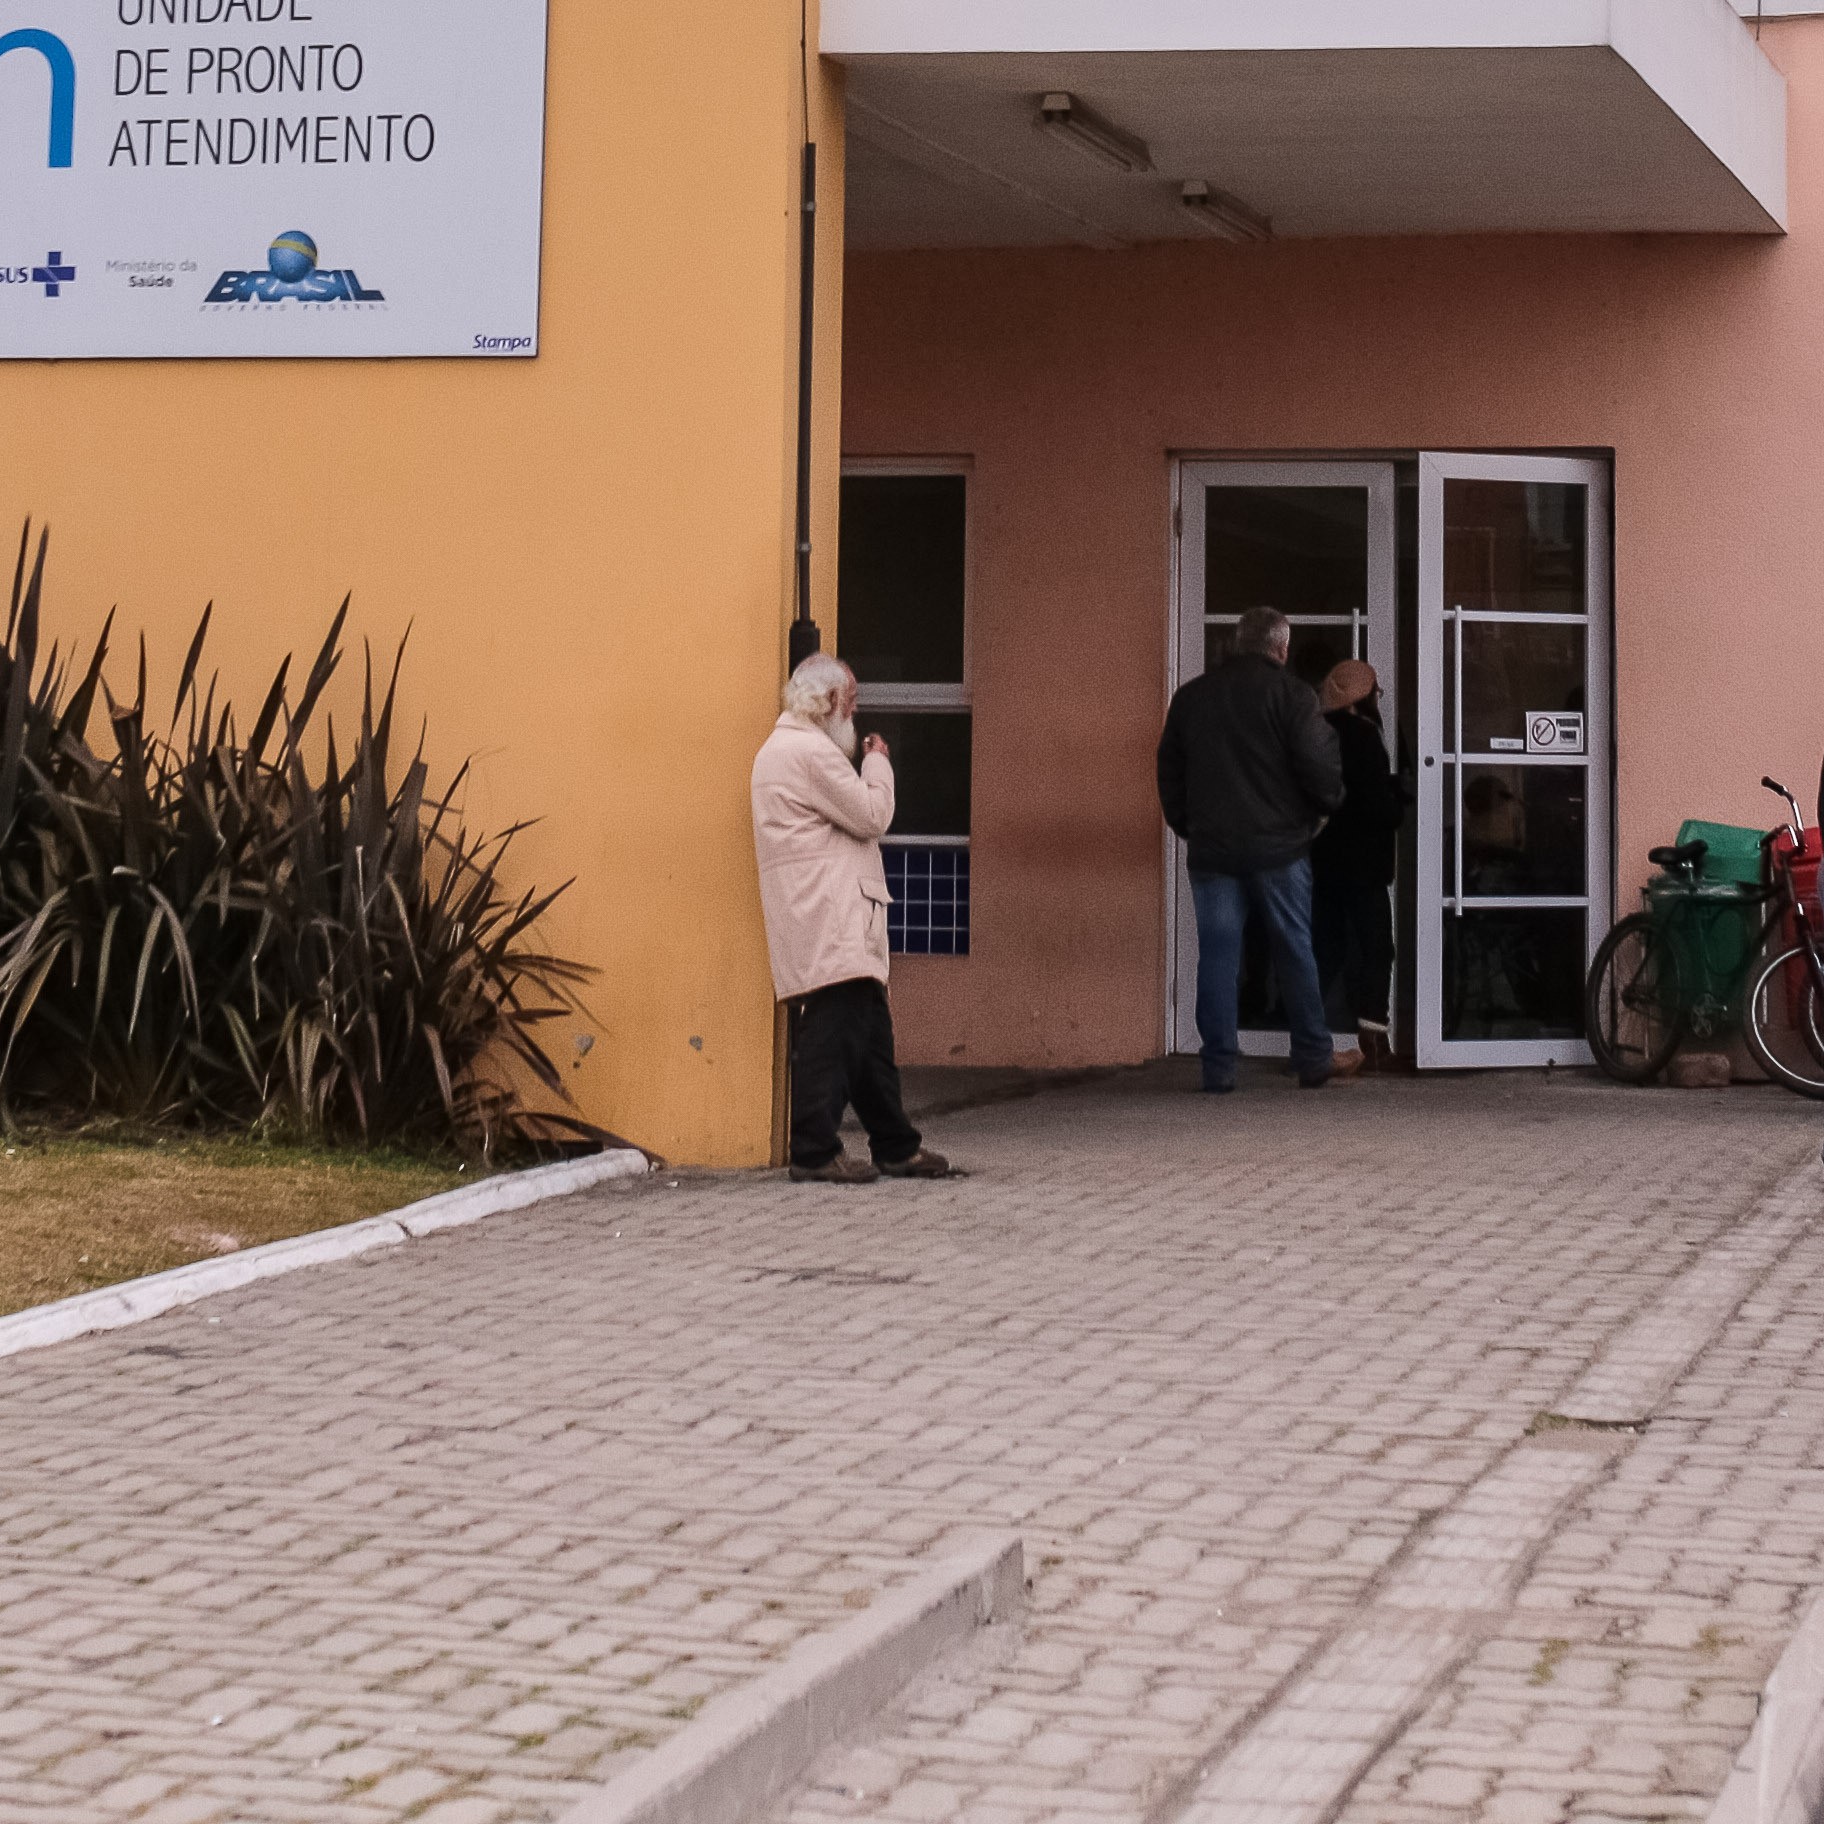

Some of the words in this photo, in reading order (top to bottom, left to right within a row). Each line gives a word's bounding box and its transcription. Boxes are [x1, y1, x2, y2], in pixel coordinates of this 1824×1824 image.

[114, 48, 169, 96] DE
[187, 43, 363, 94] PRONTO
[108, 113, 435, 167] ATENDIMENTO
[204, 269, 385, 303] BRASIL
[472, 334, 532, 352] Stampa
